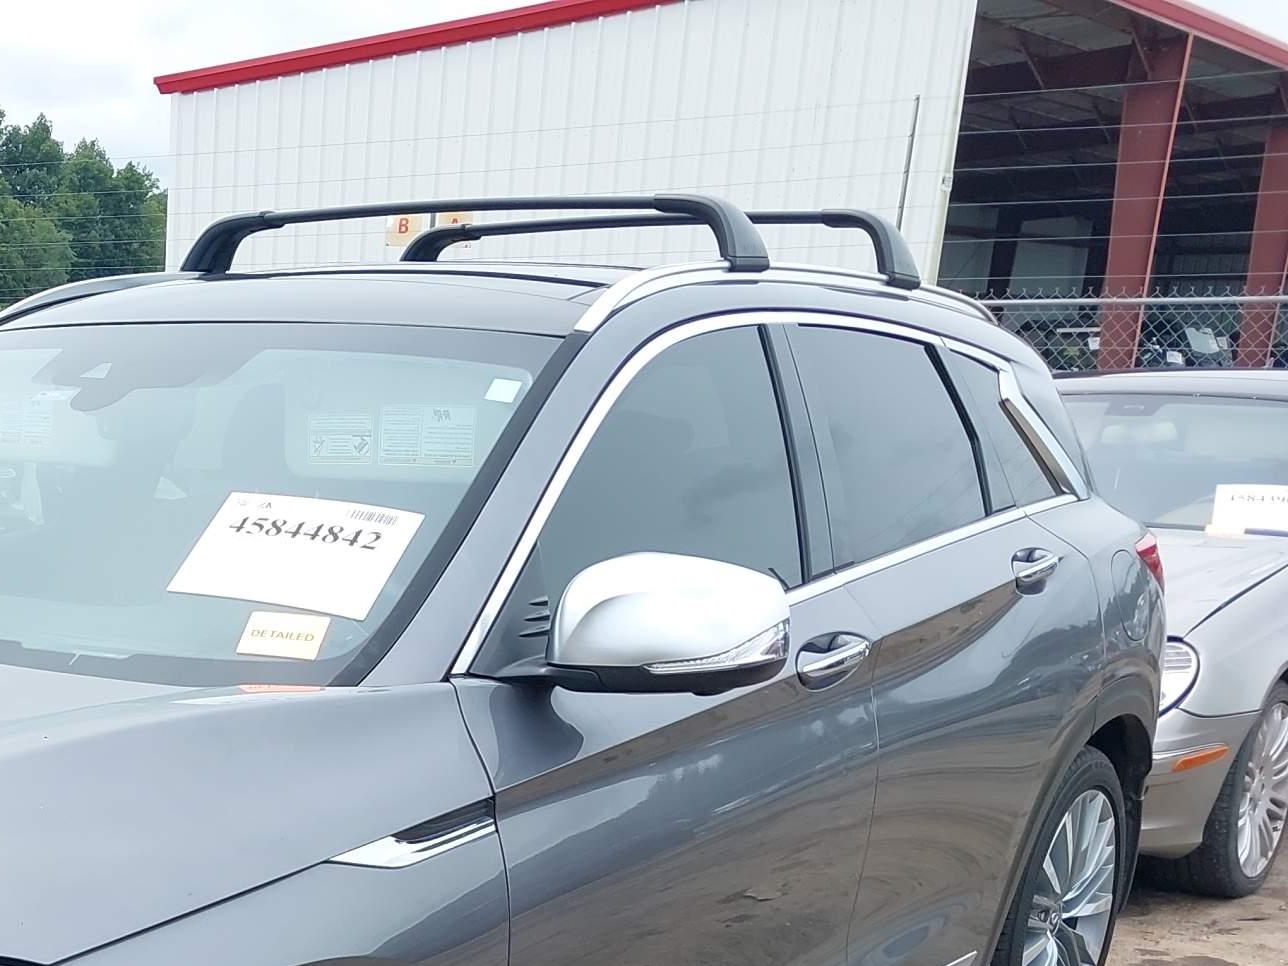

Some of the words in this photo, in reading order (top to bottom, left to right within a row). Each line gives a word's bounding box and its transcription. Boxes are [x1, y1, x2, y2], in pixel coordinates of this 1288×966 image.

[397, 217, 410, 234] B
[228, 516, 382, 550] 45844842
[250, 629, 315, 642] DETAILED
